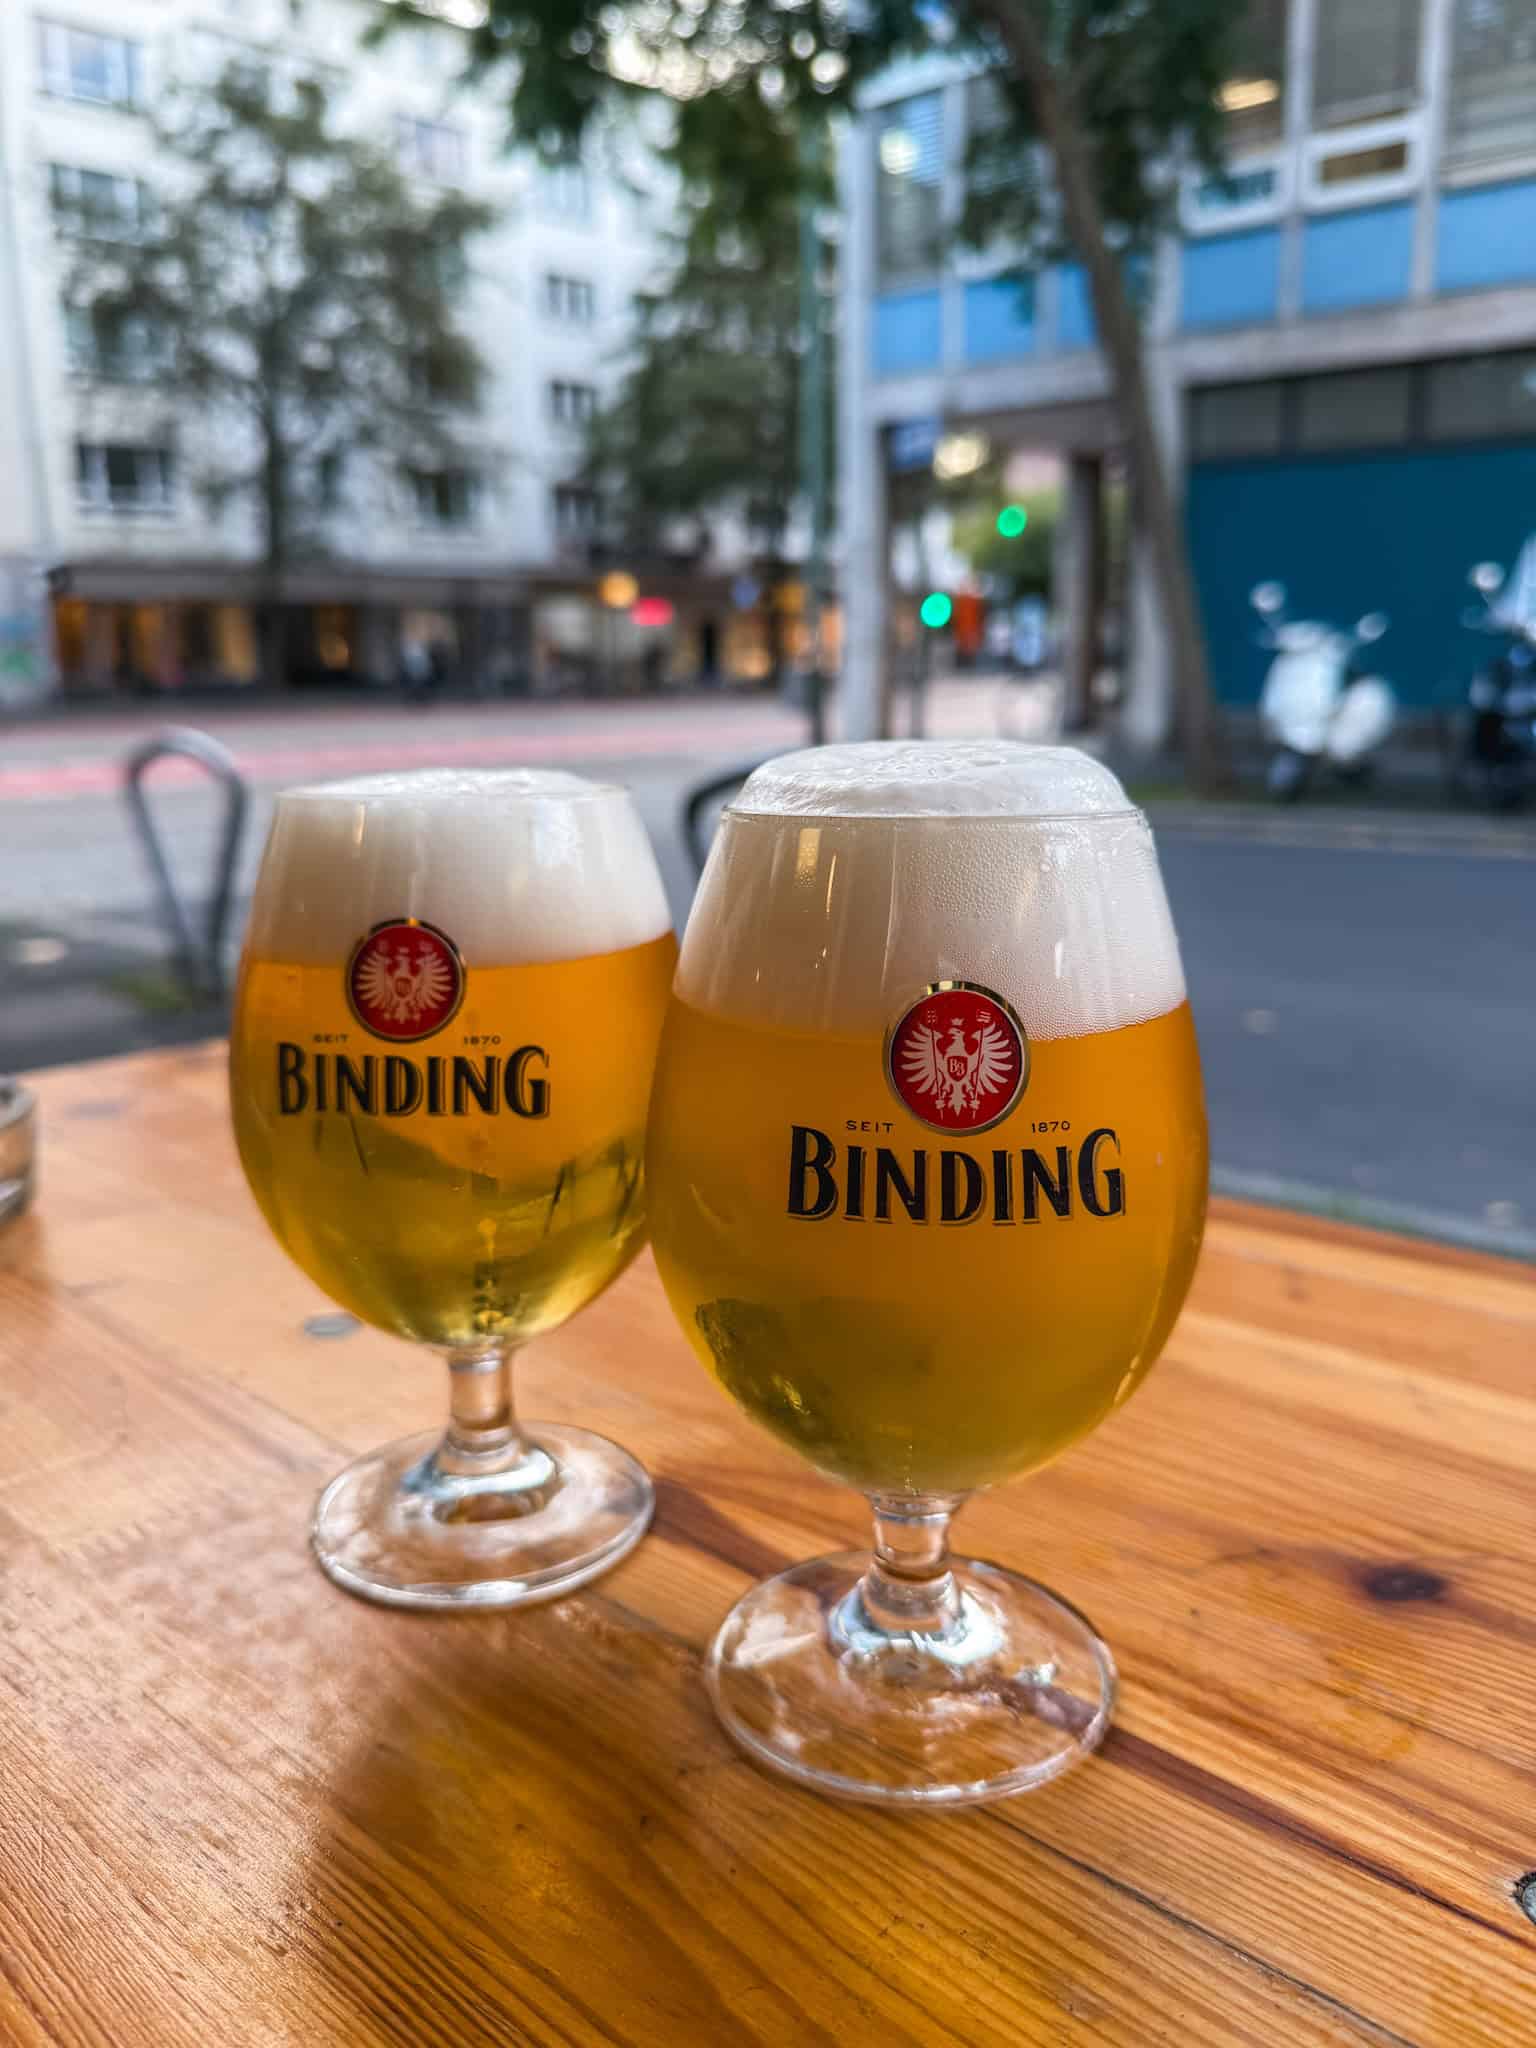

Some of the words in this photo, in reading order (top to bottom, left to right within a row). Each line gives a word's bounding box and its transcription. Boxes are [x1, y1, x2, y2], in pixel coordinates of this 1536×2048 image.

[313, 1033, 349, 1044] SEIT
[463, 1036, 501, 1046] 1870
[277, 1042, 550, 1118] BINDING
[845, 1119, 894, 1133] SEIT
[1030, 1120, 1071, 1134] 1870
[787, 1125, 1125, 1225] BINDING
